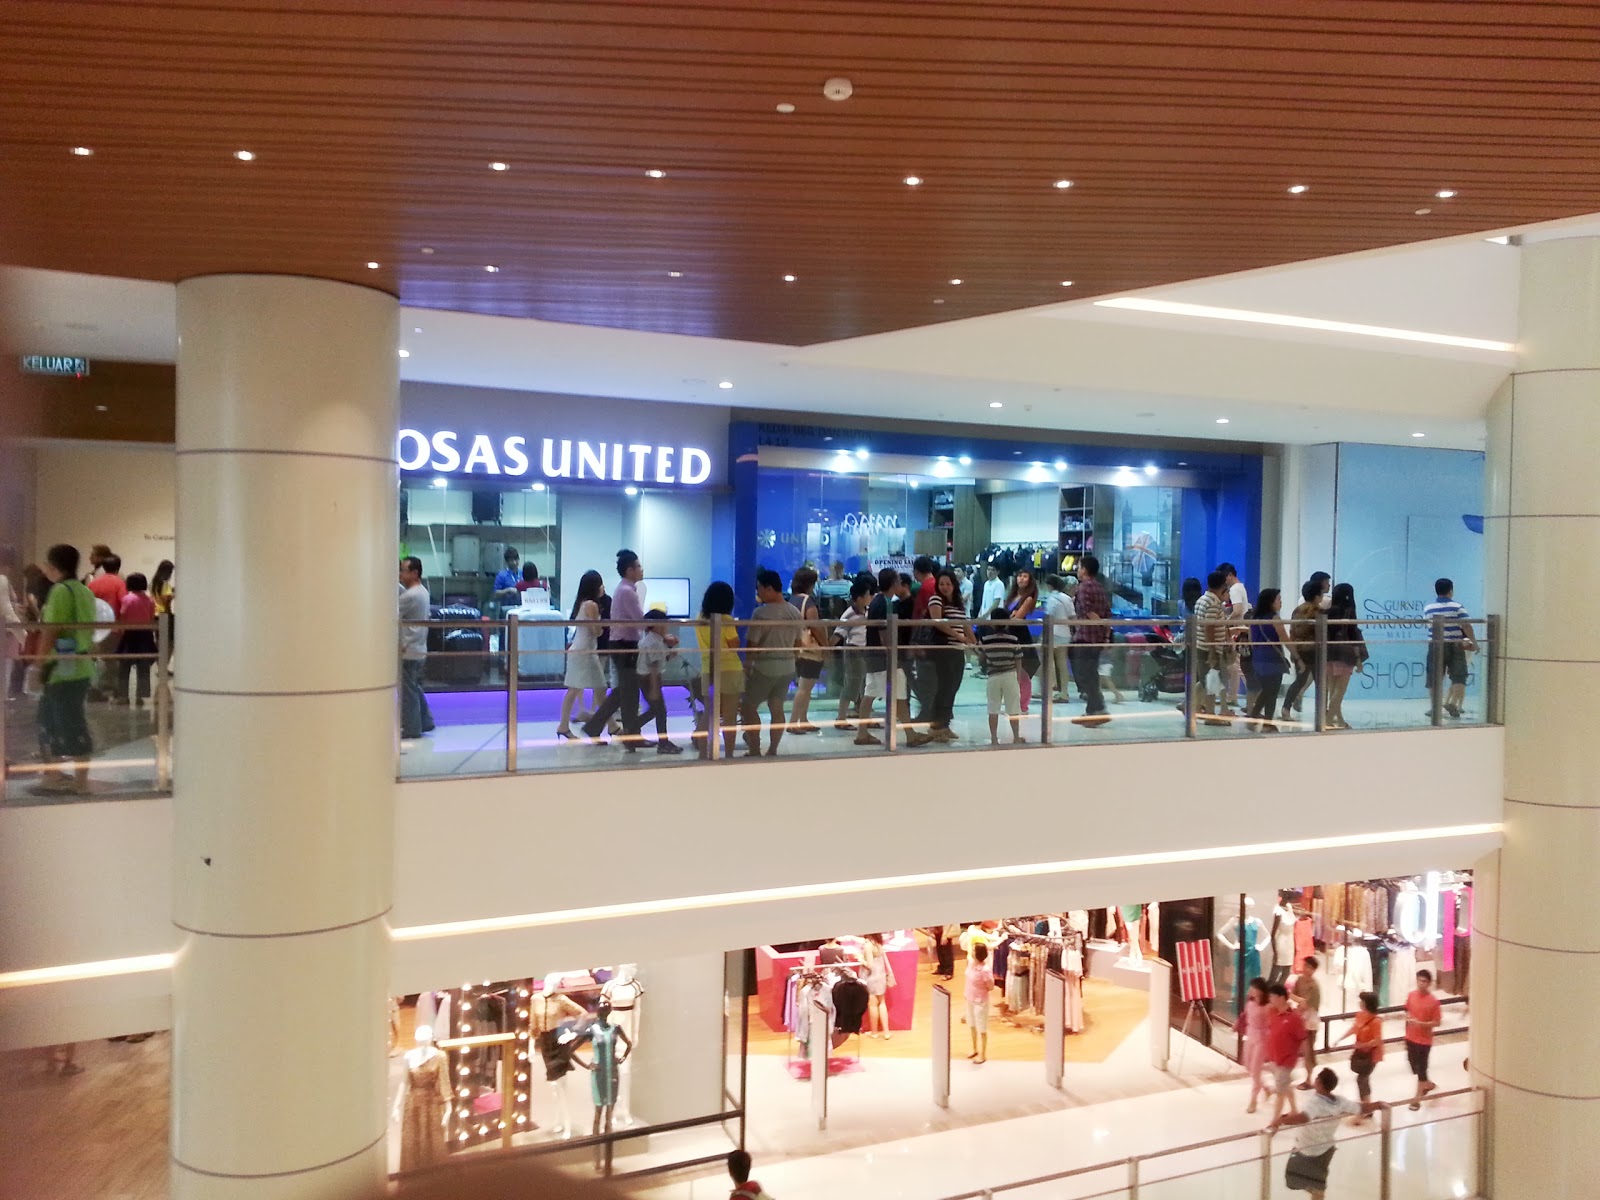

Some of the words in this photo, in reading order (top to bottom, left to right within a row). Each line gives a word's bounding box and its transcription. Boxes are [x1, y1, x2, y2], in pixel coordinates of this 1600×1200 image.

[23, 356, 72, 373] KELUAR
[398, 429, 529, 477] OSAS
[542, 438, 712, 485] UNITED
[1383, 600, 1426, 612] GURNEY
